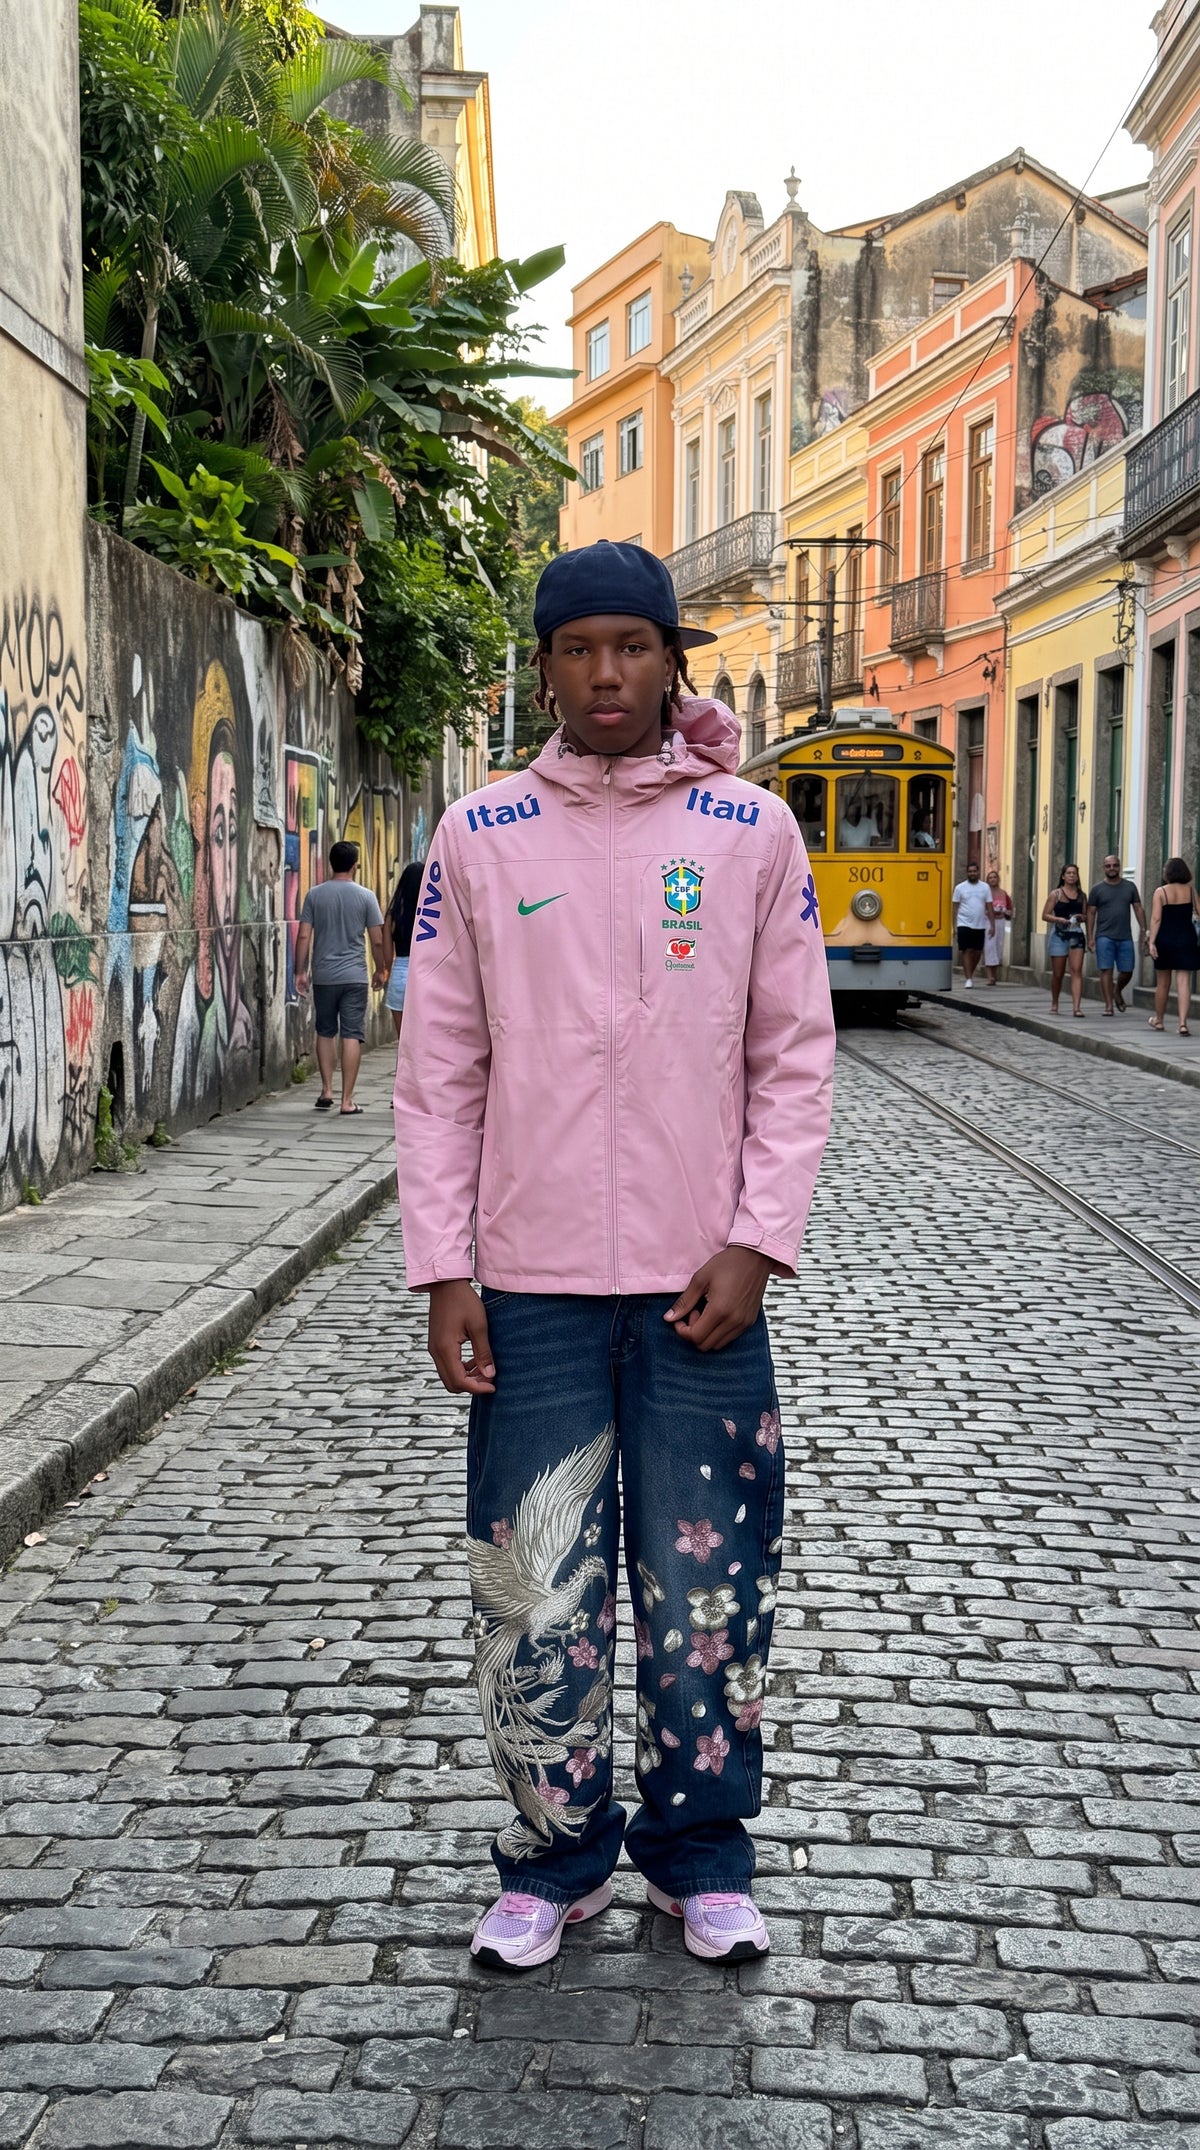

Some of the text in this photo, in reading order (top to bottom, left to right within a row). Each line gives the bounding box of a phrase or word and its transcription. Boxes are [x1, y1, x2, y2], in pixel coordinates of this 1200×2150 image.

[466, 793, 541, 833] Itaú
[686, 787, 760, 826] Itaú
[415, 860, 442, 942] vivo
[661, 919, 703, 931] BRASIL
